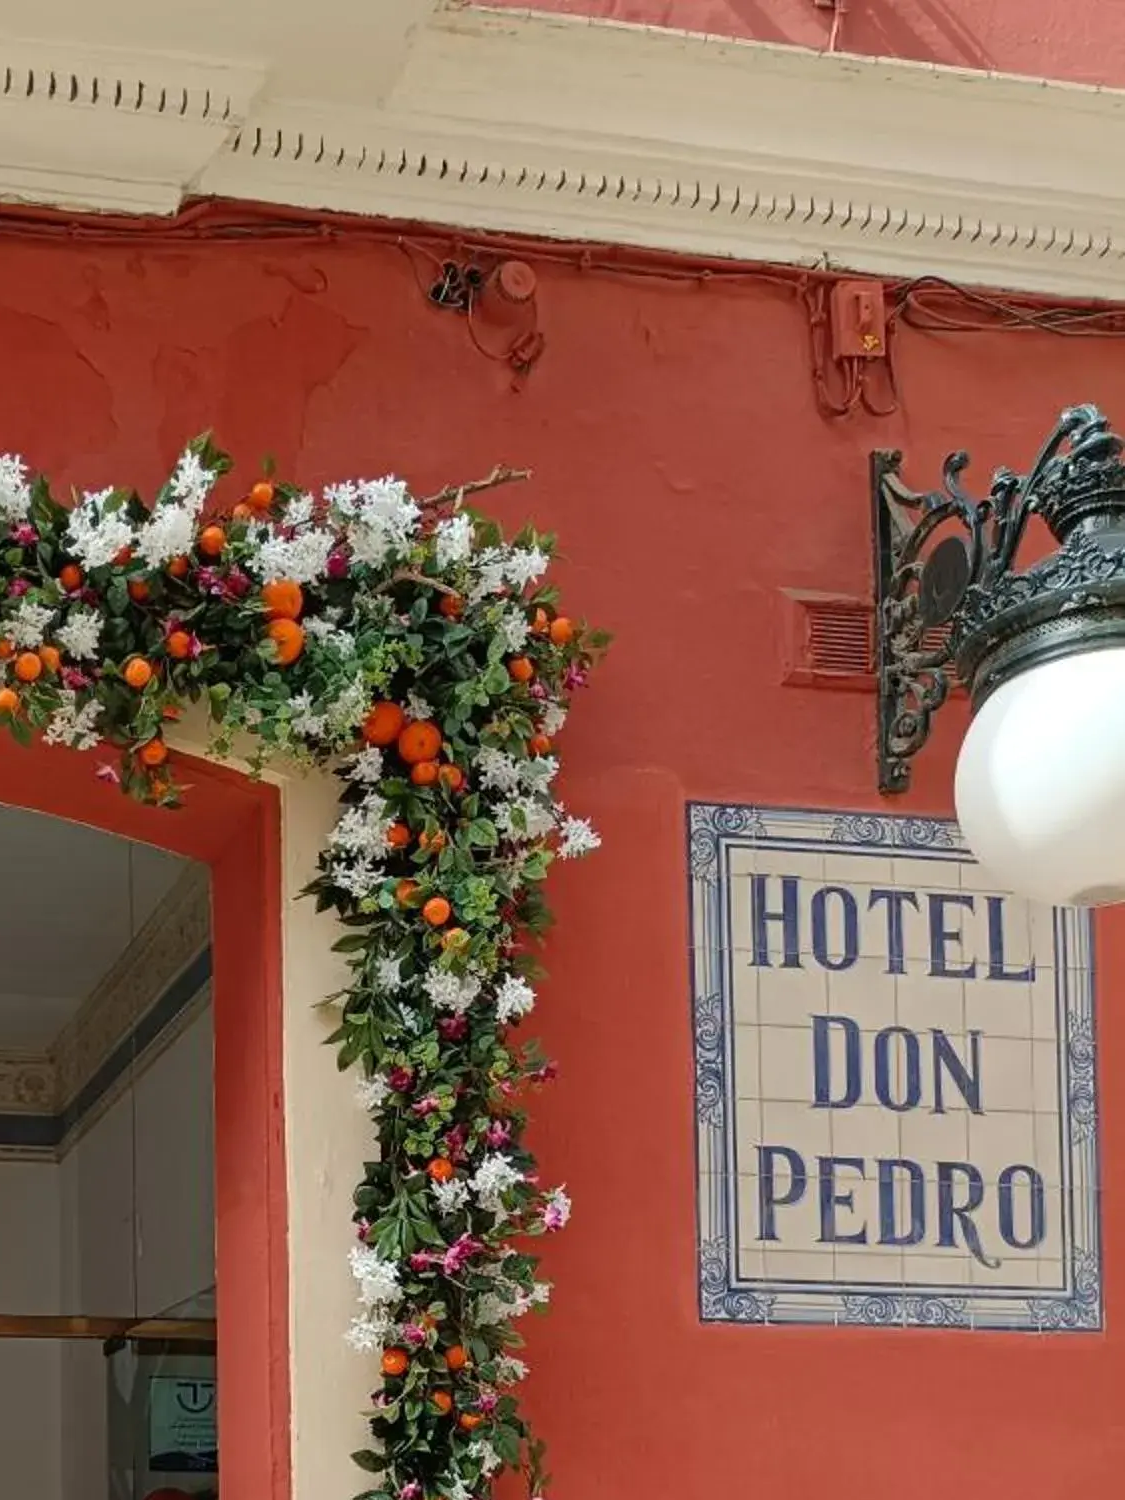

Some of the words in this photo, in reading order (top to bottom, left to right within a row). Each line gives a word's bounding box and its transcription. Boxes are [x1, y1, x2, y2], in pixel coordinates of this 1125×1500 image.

[747, 872, 1037, 984] HOTEL
[808, 1014, 986, 1115] DON
[754, 1144, 1048, 1269] PEDRO
